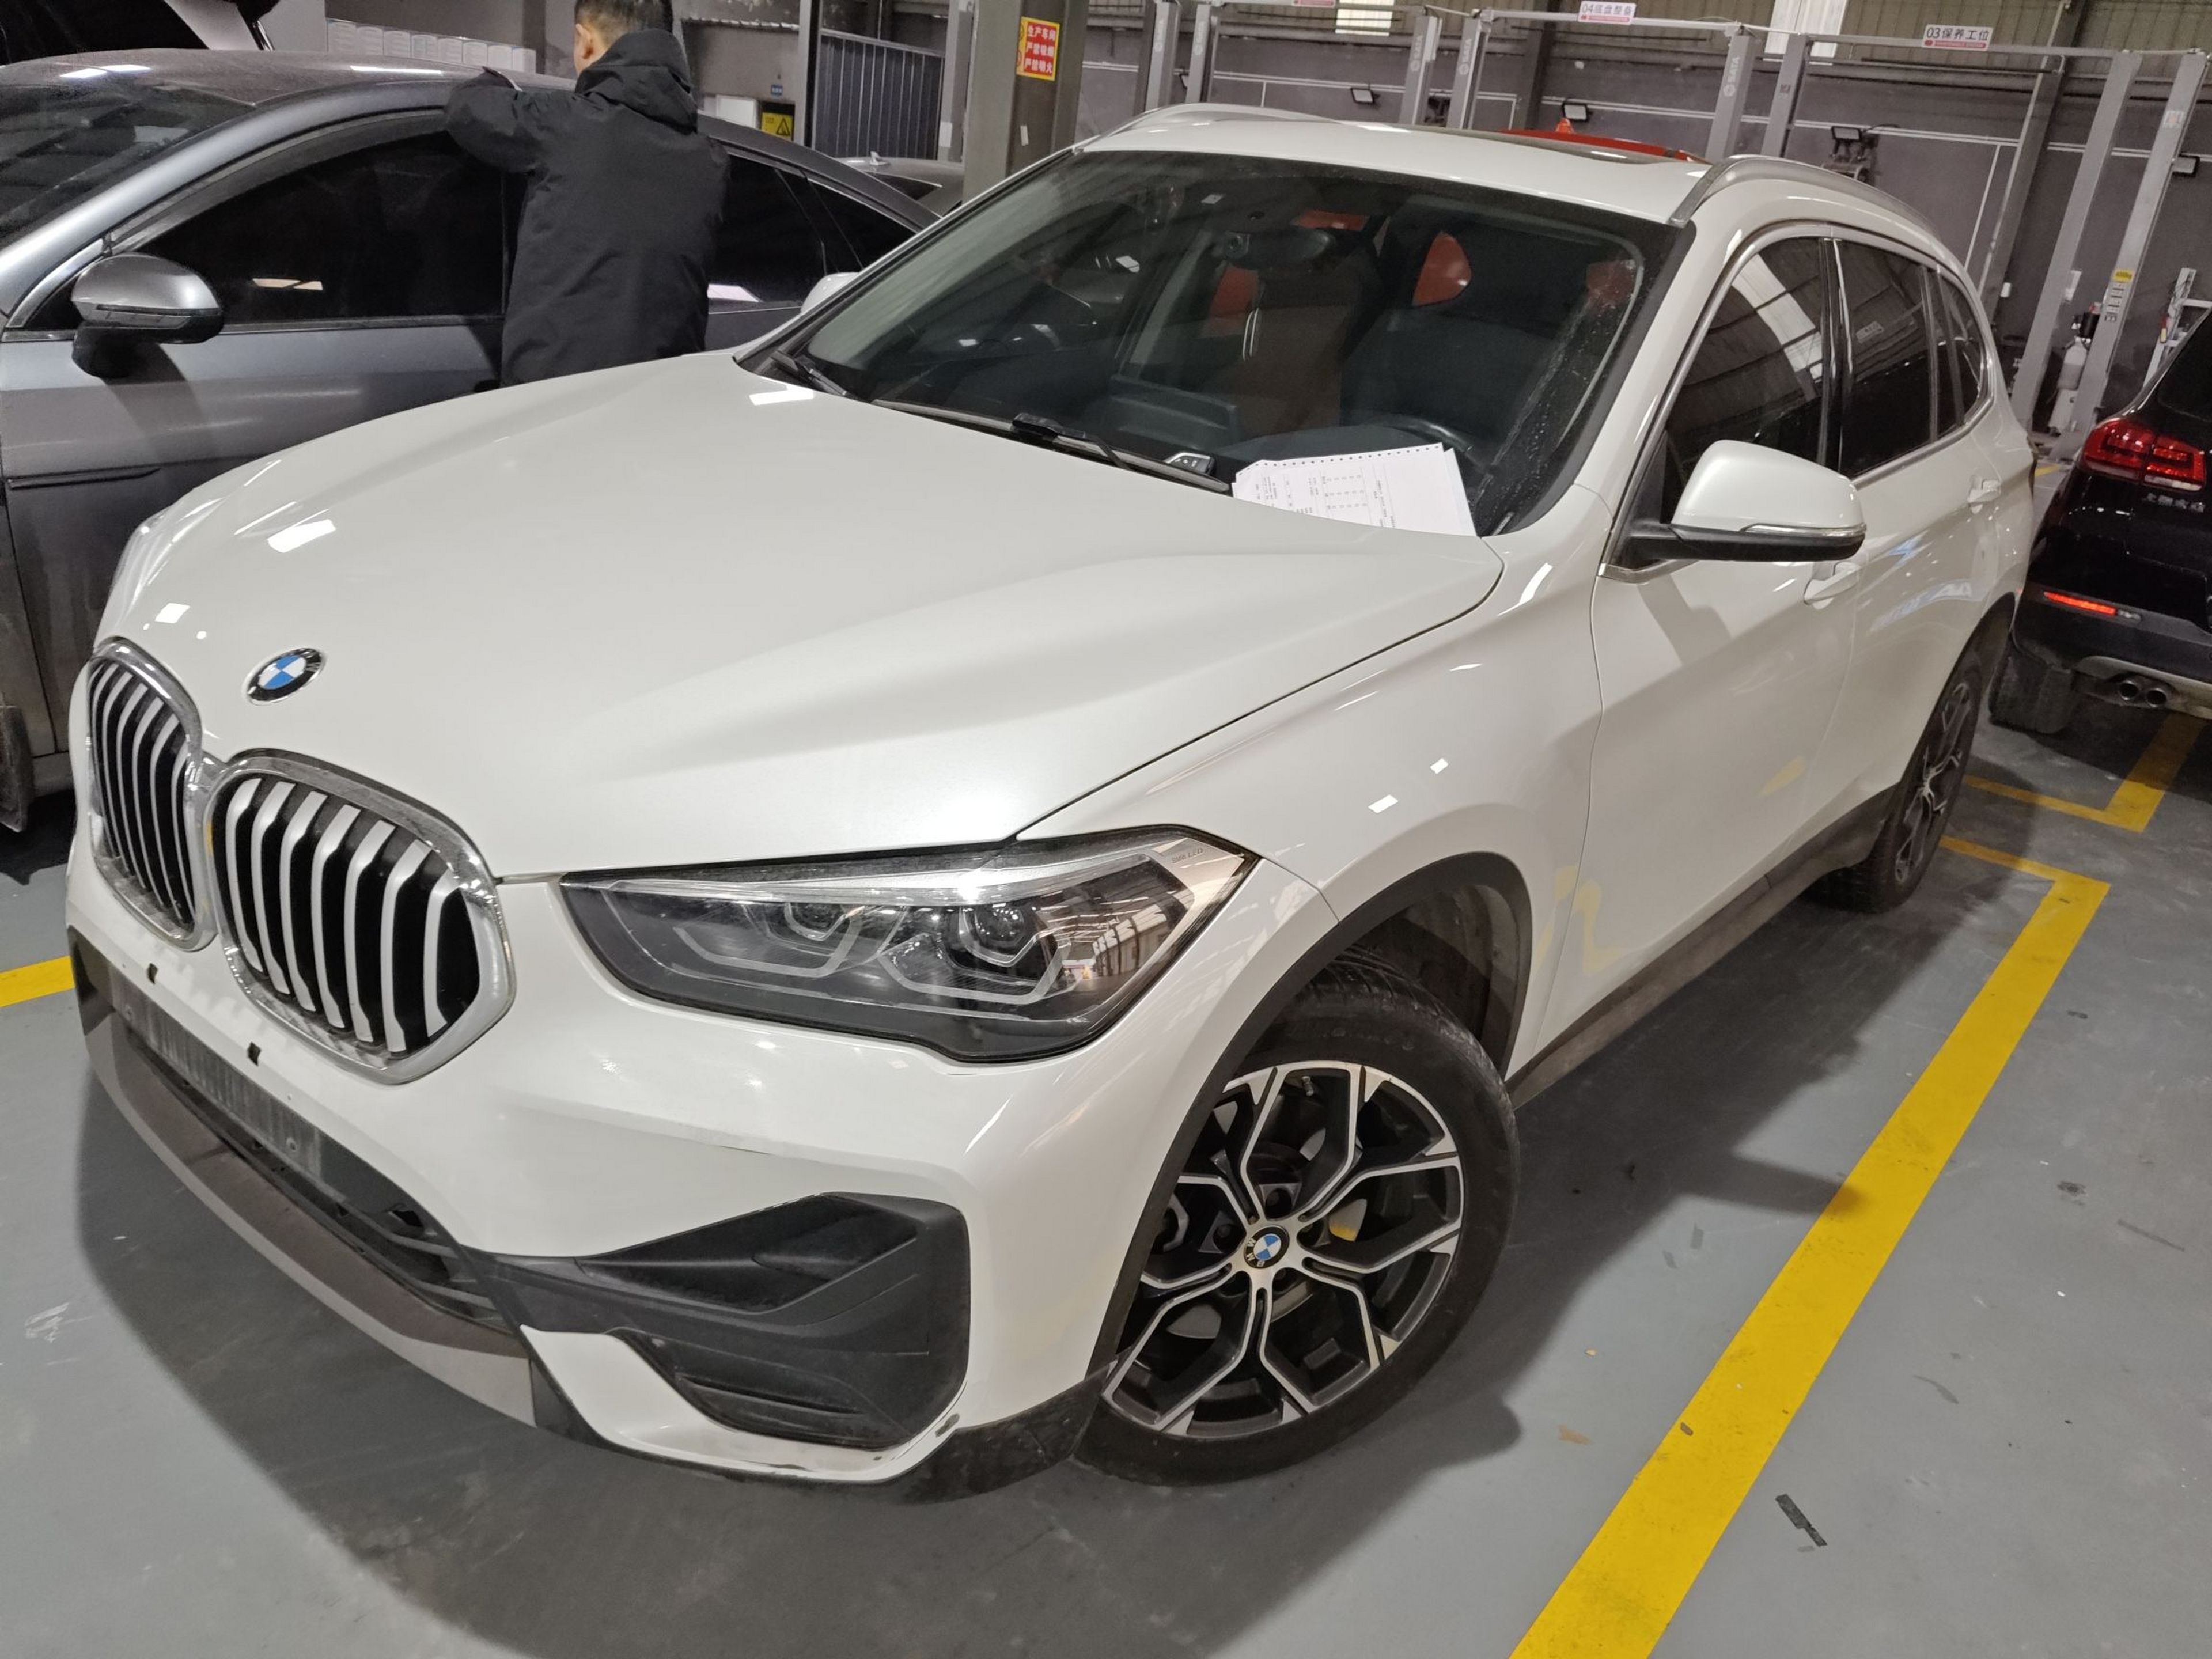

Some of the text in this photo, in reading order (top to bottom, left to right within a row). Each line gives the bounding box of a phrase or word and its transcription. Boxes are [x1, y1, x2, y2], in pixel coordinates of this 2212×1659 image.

[1027, 25, 1056, 41] 生产车间
[1926, 27, 1989, 41] 03保养工位
[1246, 1238, 1265, 1267] BMW
